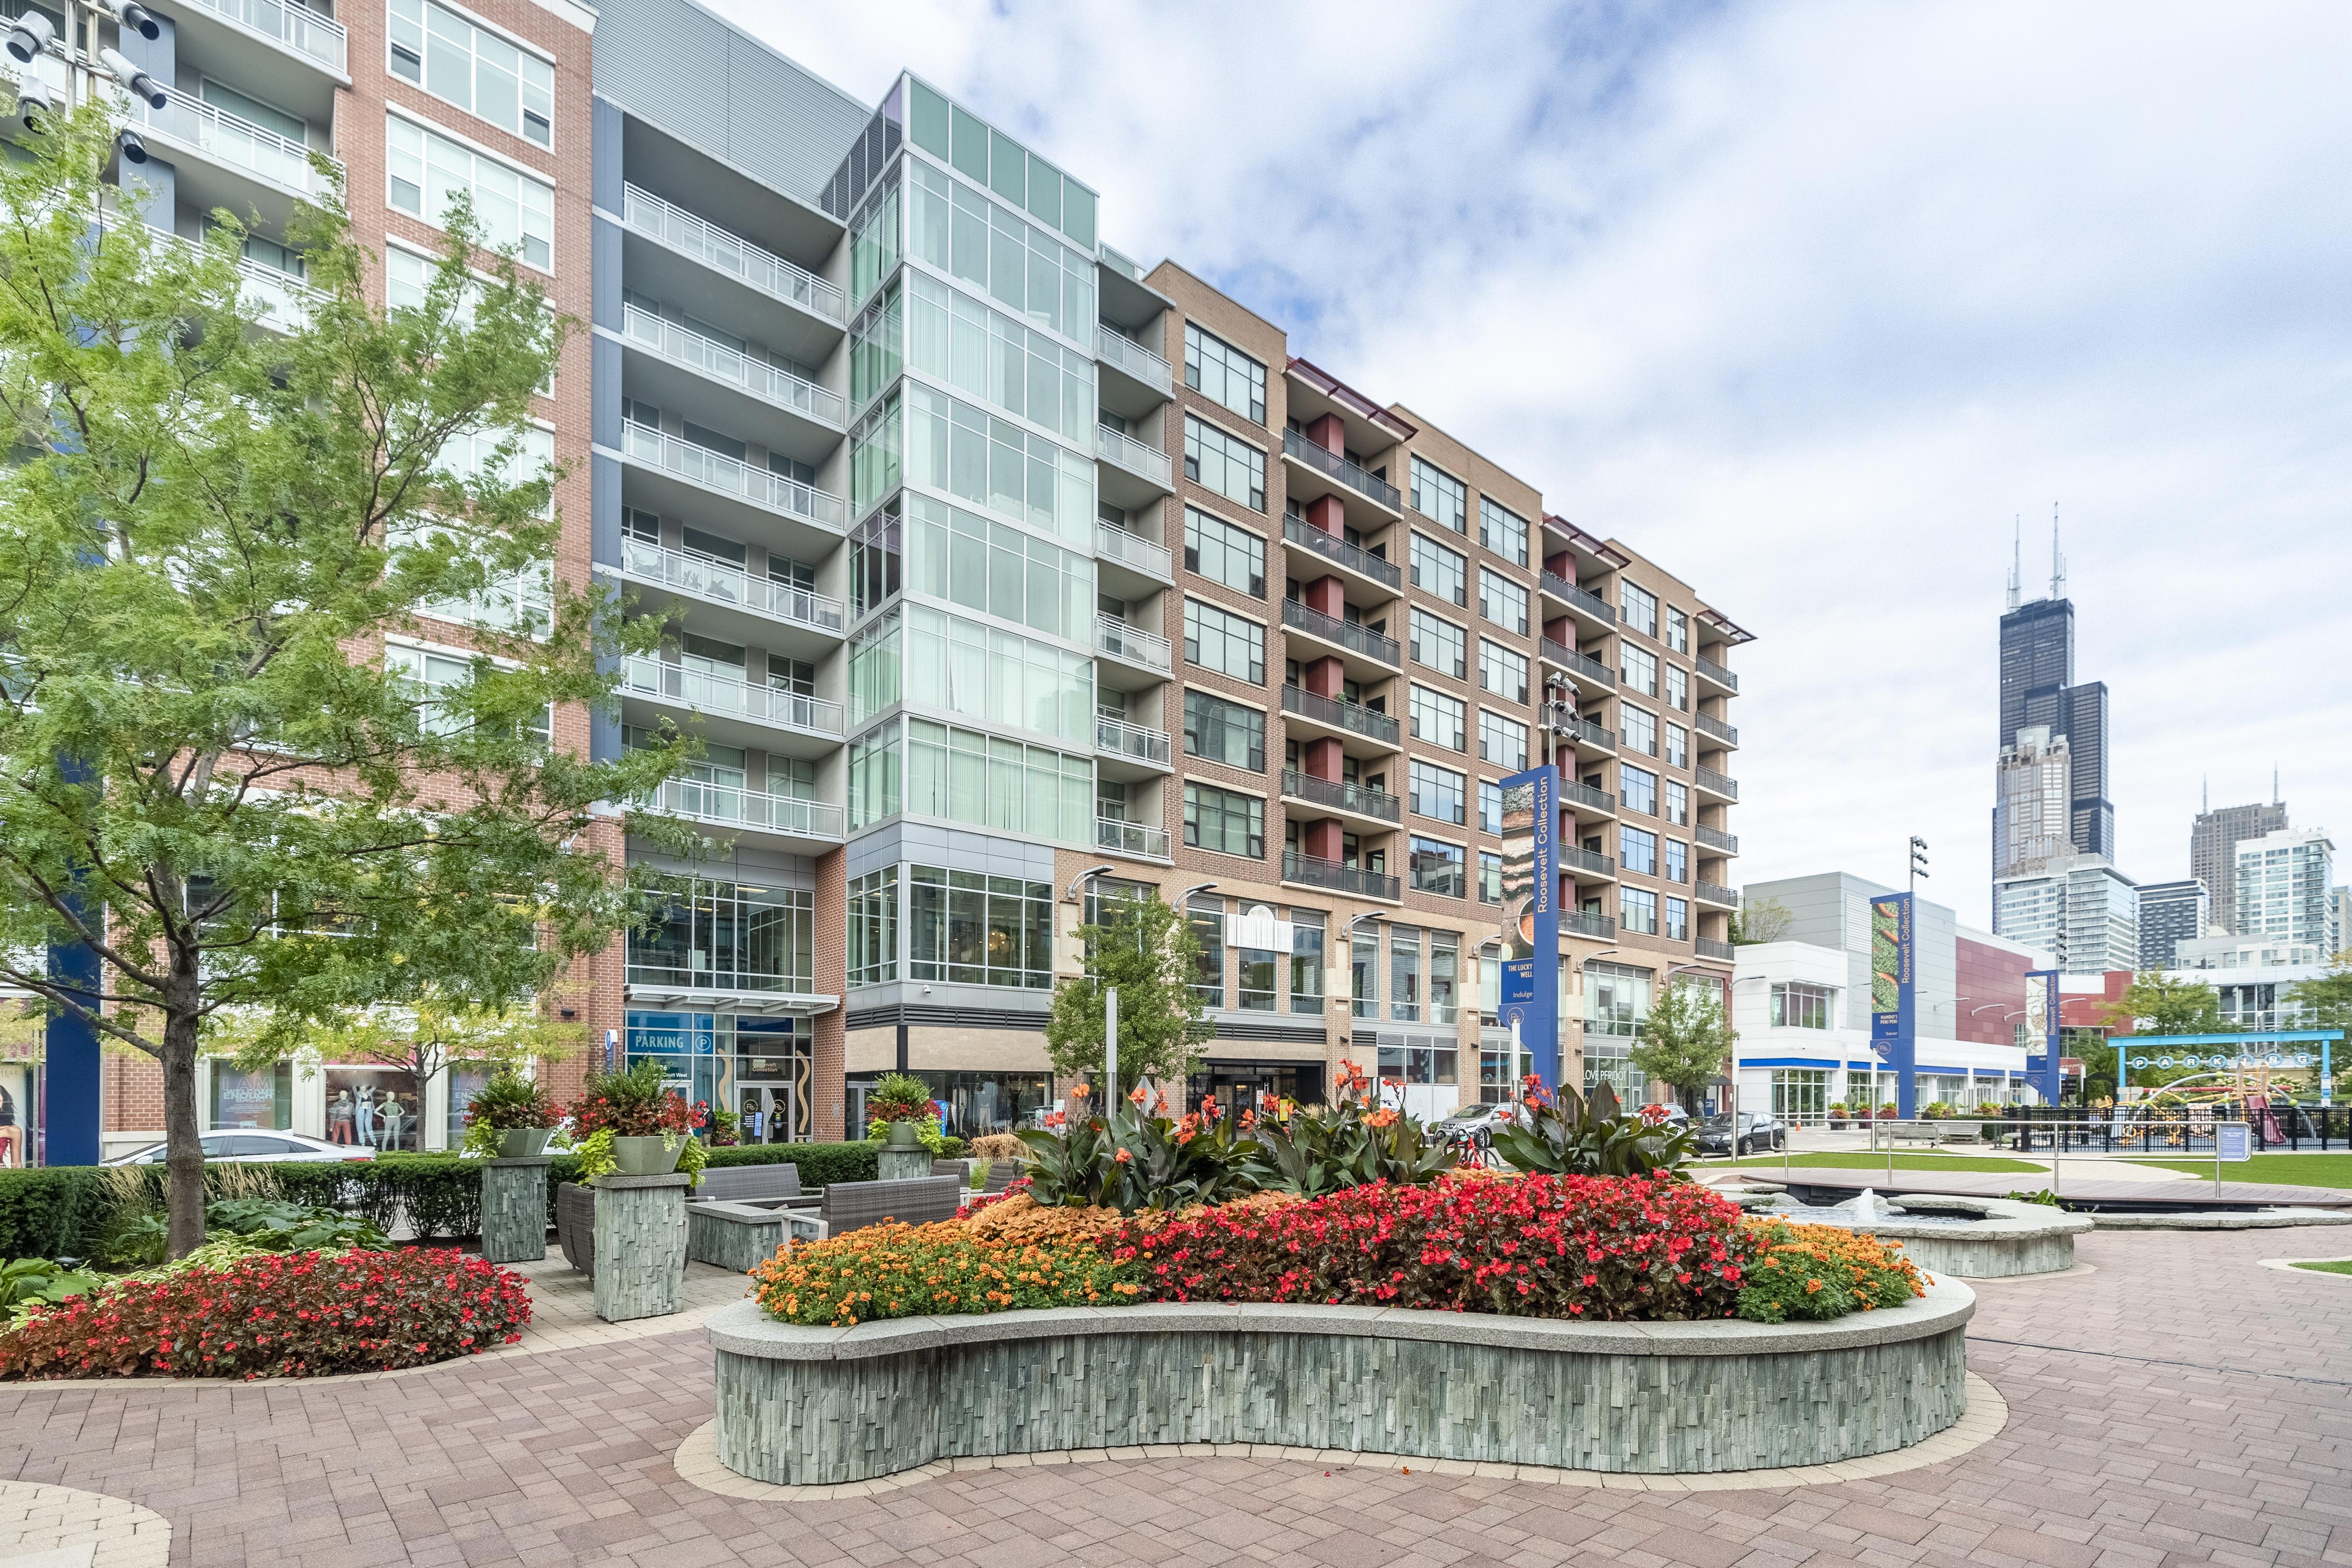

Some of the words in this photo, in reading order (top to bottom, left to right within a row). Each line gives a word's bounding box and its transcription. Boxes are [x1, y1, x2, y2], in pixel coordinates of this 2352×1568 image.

[1538, 776, 1547, 844] Collection
[1538, 847, 1547, 913] Roosevelt
[1902, 898, 1910, 941] Collection
[636, 1035, 684, 1048] PARKING
[700, 1038, 707, 1048] P
[1600, 1070, 1626, 1081] PERIDOT
[223, 1077, 228, 1090] I
[236, 1076, 272, 1090] AM
